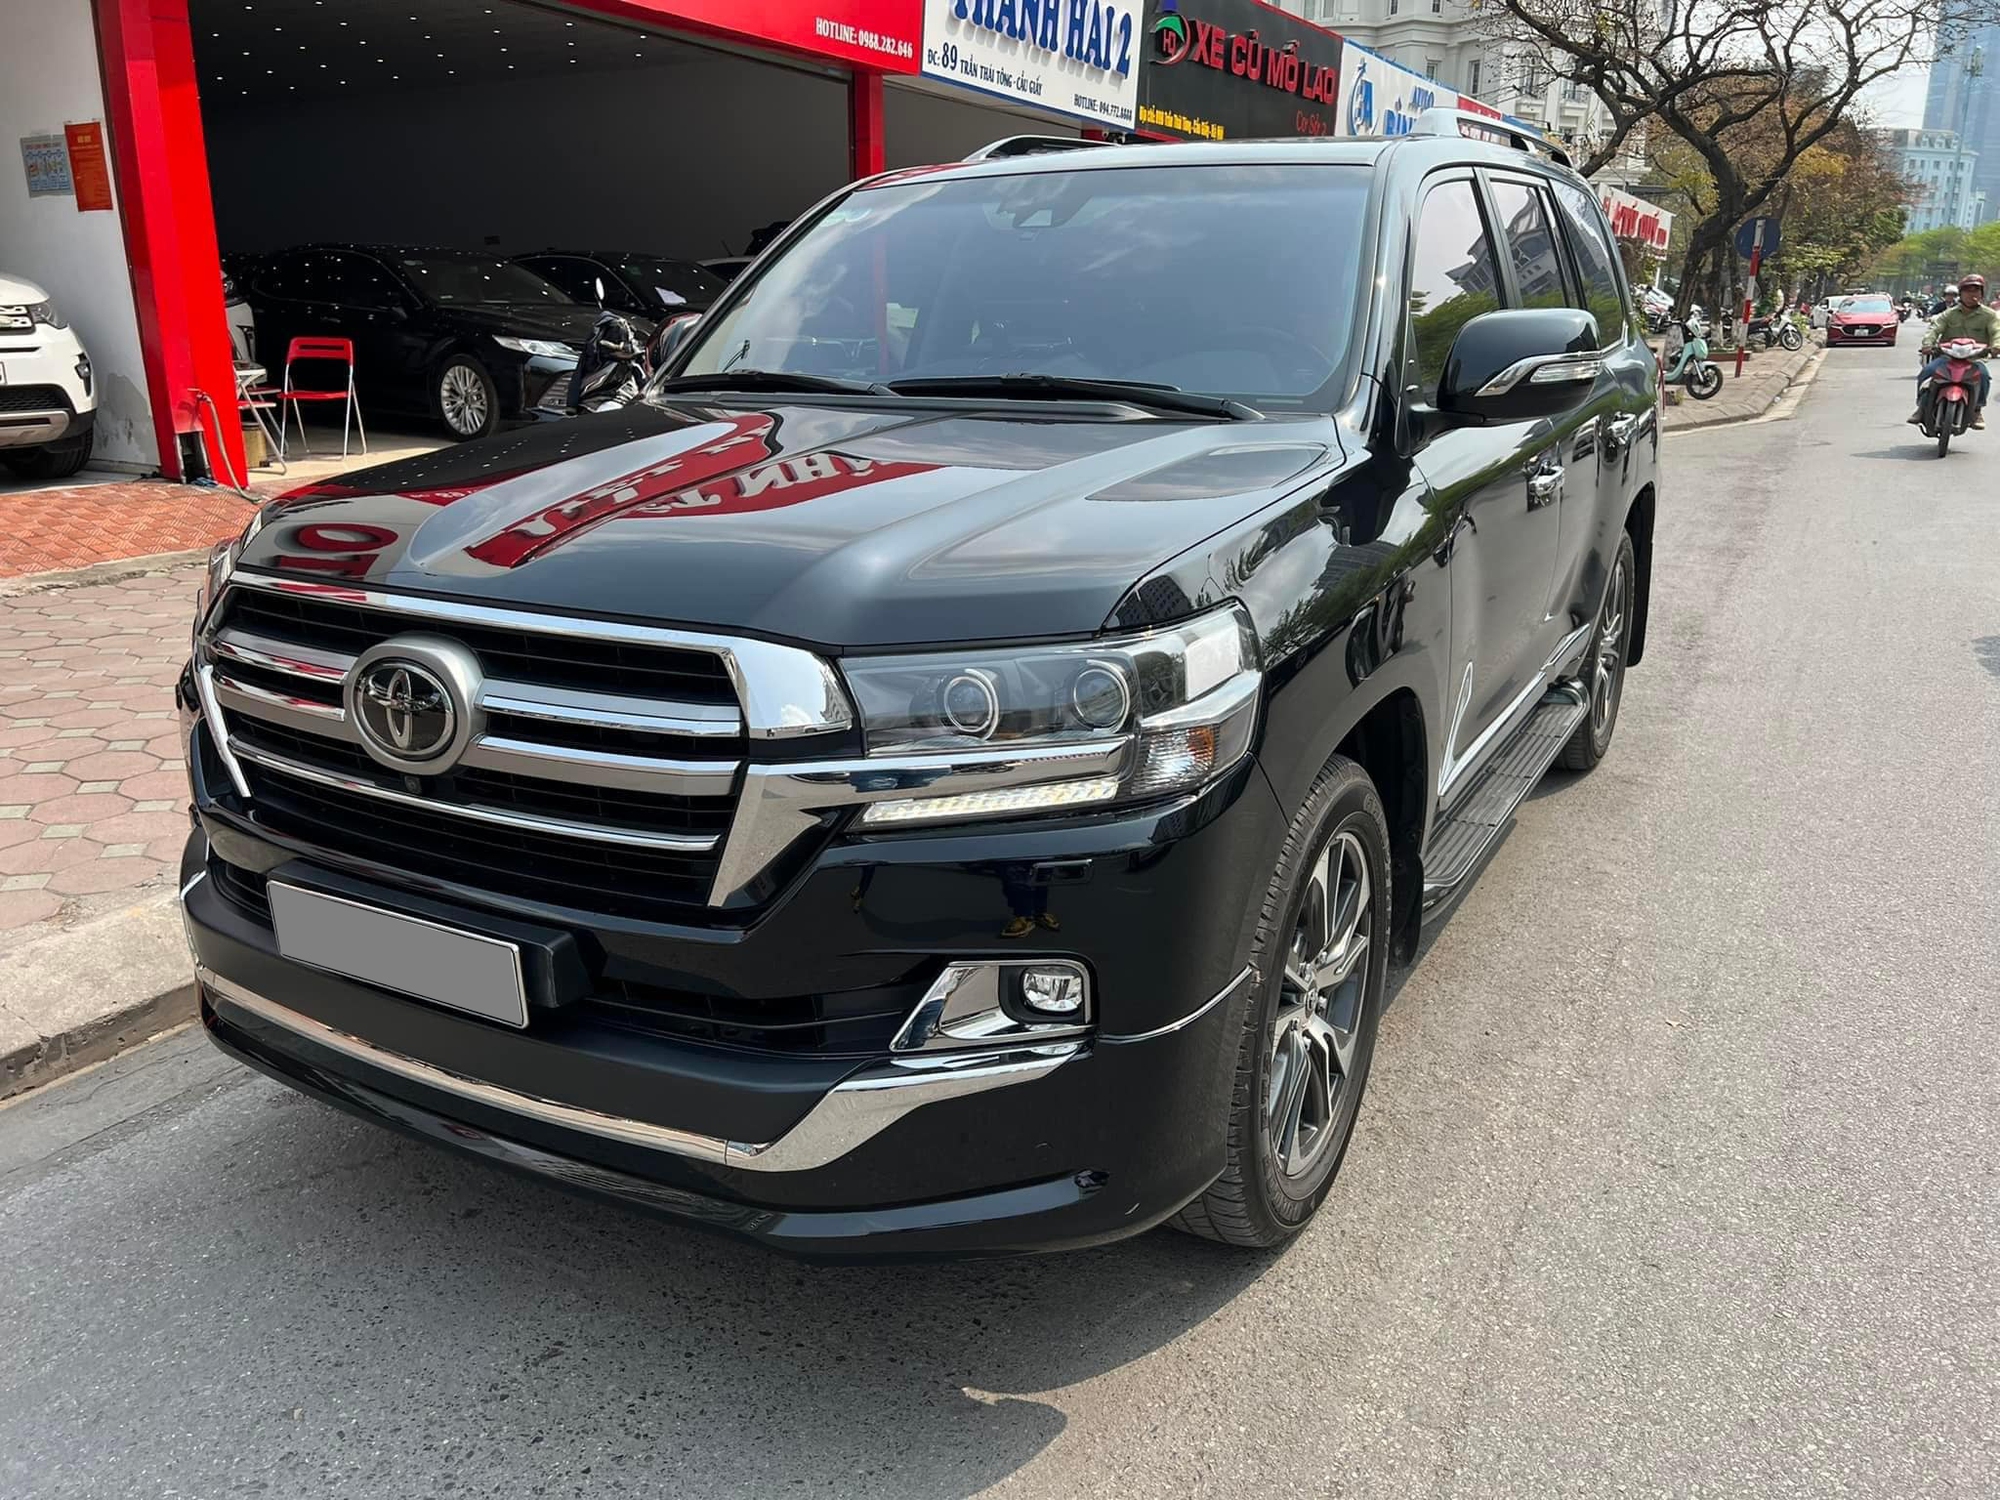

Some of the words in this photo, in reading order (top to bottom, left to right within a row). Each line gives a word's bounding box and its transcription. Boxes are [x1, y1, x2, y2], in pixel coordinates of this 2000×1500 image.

[815, 16, 857, 46] HOTLINE:
[858, 29, 913, 59] 0988.282.646
[941, 41, 958, 71] 89
[955, 0, 1059, 52] ANH
[1117, 12, 1132, 80] 2
[1194, 19, 1226, 70] XE
[1303, 61, 1336, 104] LAO
[1074, 94, 1098, 112] HOTLINE:
